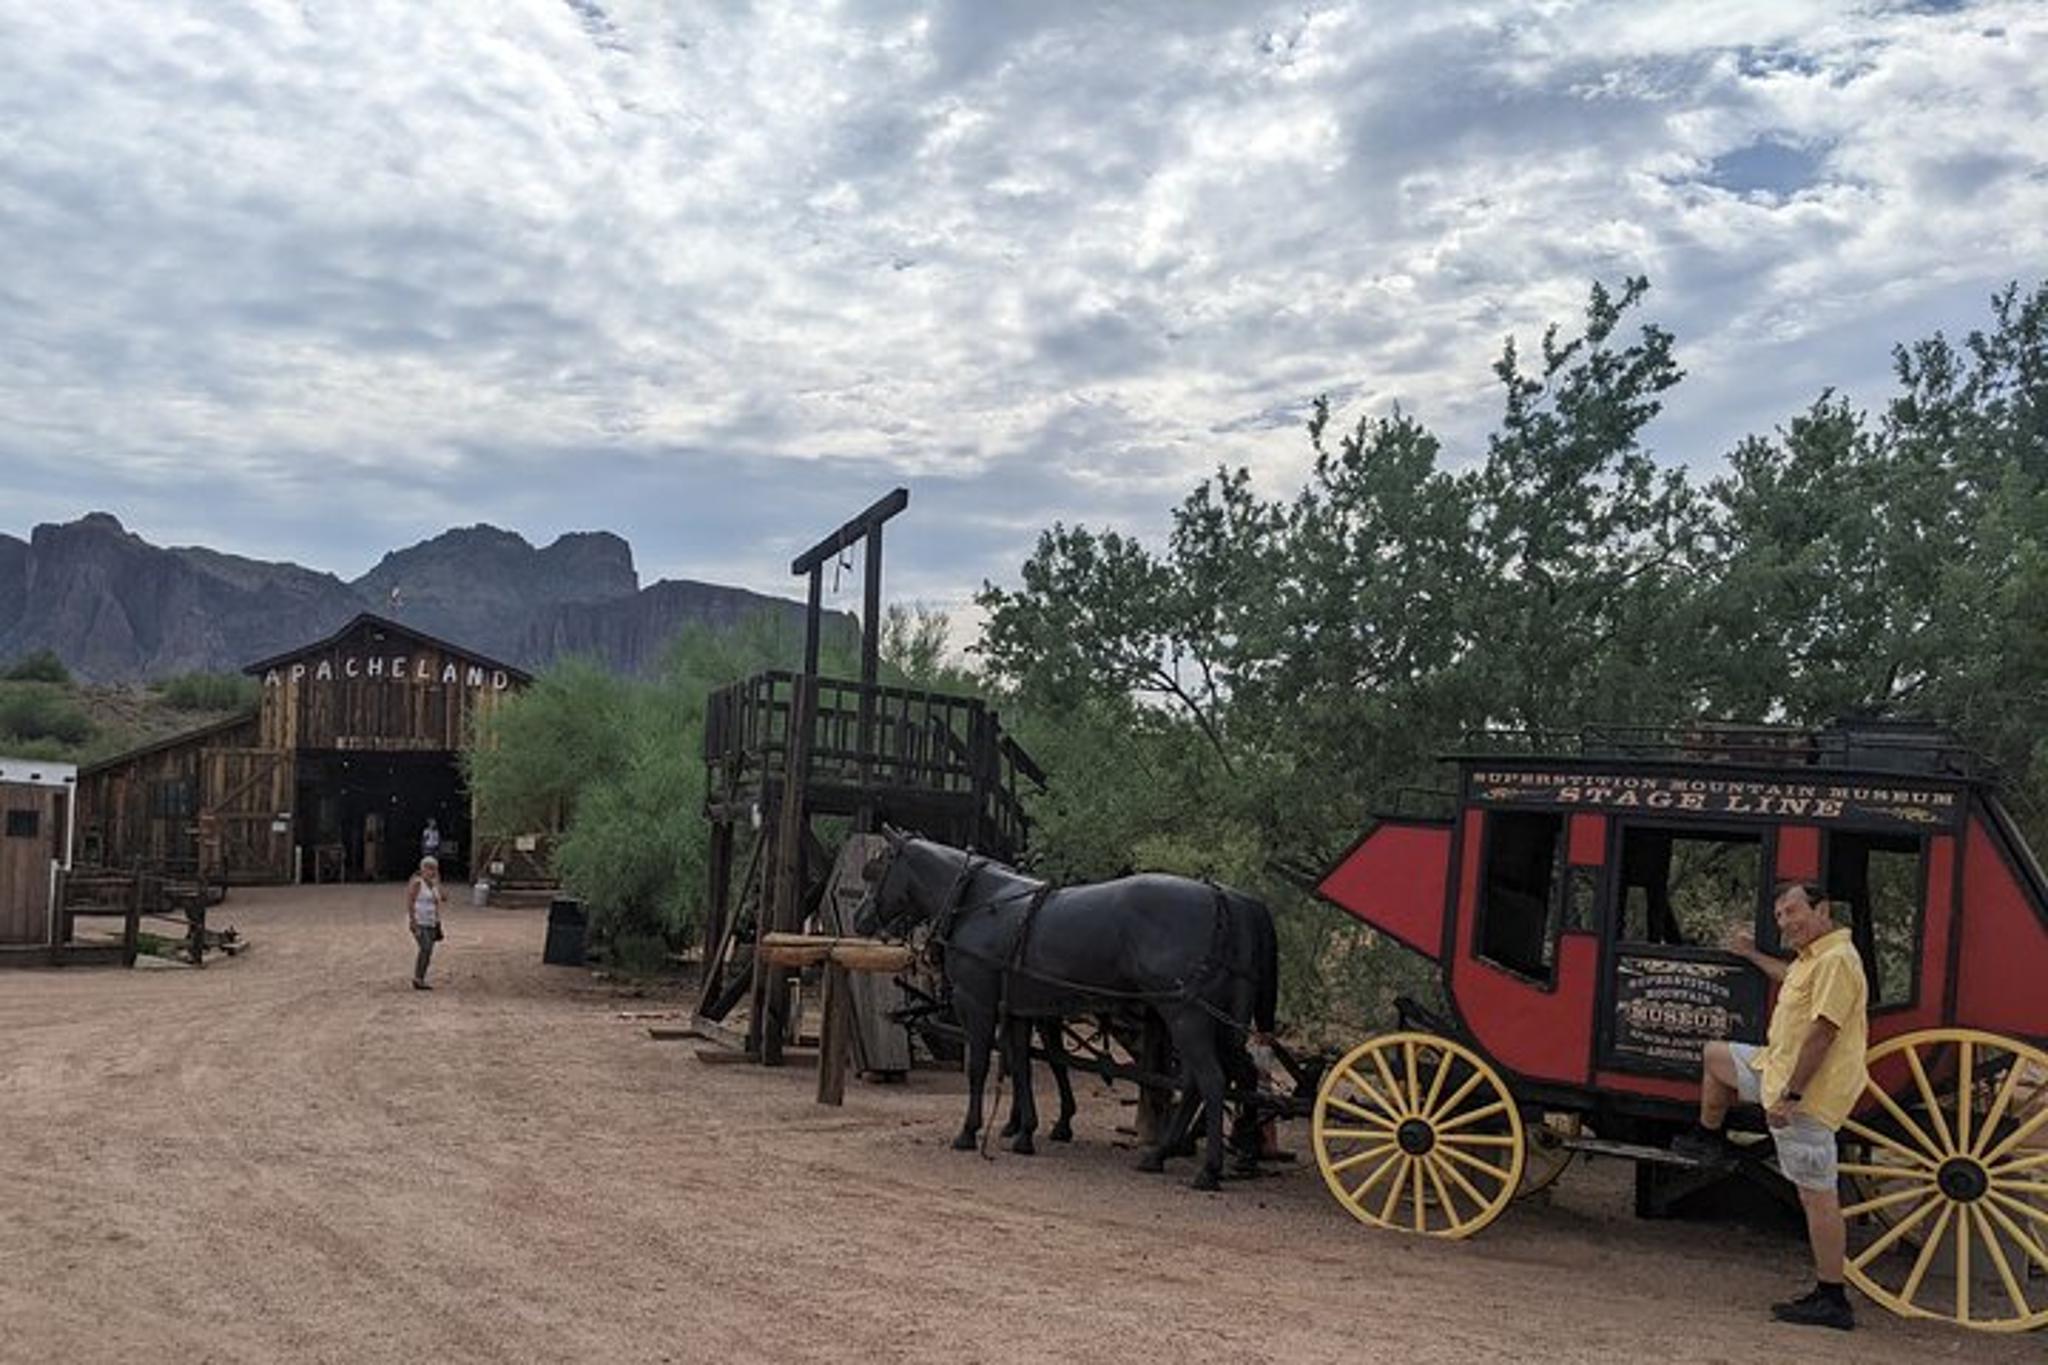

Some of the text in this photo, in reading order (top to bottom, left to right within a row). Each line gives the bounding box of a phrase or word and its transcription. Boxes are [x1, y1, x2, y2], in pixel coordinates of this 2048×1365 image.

[264, 656, 508, 690] APACHELAND
[1472, 772, 1955, 805] SUPERSTITION MOUNTAIN MUSEUM
[1556, 786, 1844, 818] STAGE LINE
[1630, 1005, 1728, 1028] MUSEUM
